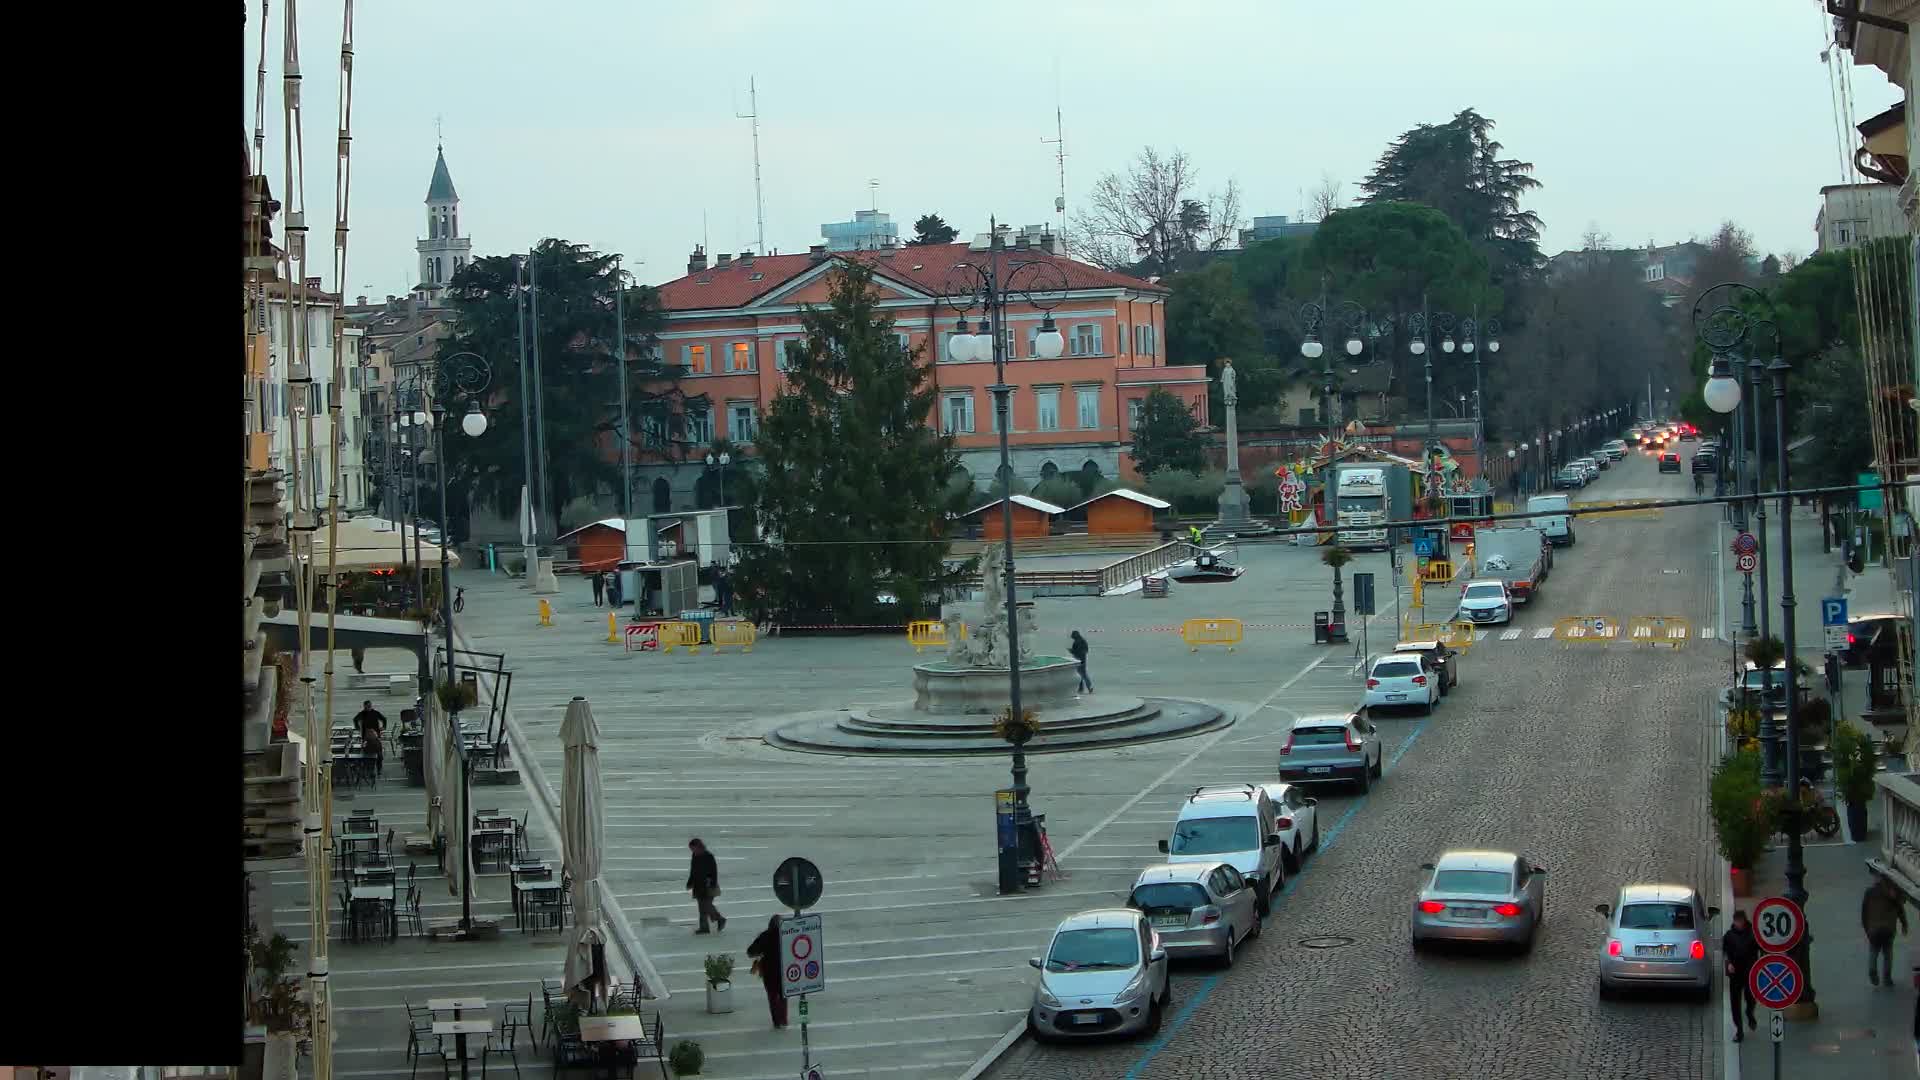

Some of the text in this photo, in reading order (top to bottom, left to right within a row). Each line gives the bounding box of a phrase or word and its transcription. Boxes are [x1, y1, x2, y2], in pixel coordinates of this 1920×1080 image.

[1742, 557, 1753, 567] 20
[1827, 602, 1842, 621] P
[1762, 911, 1792, 937] 30
